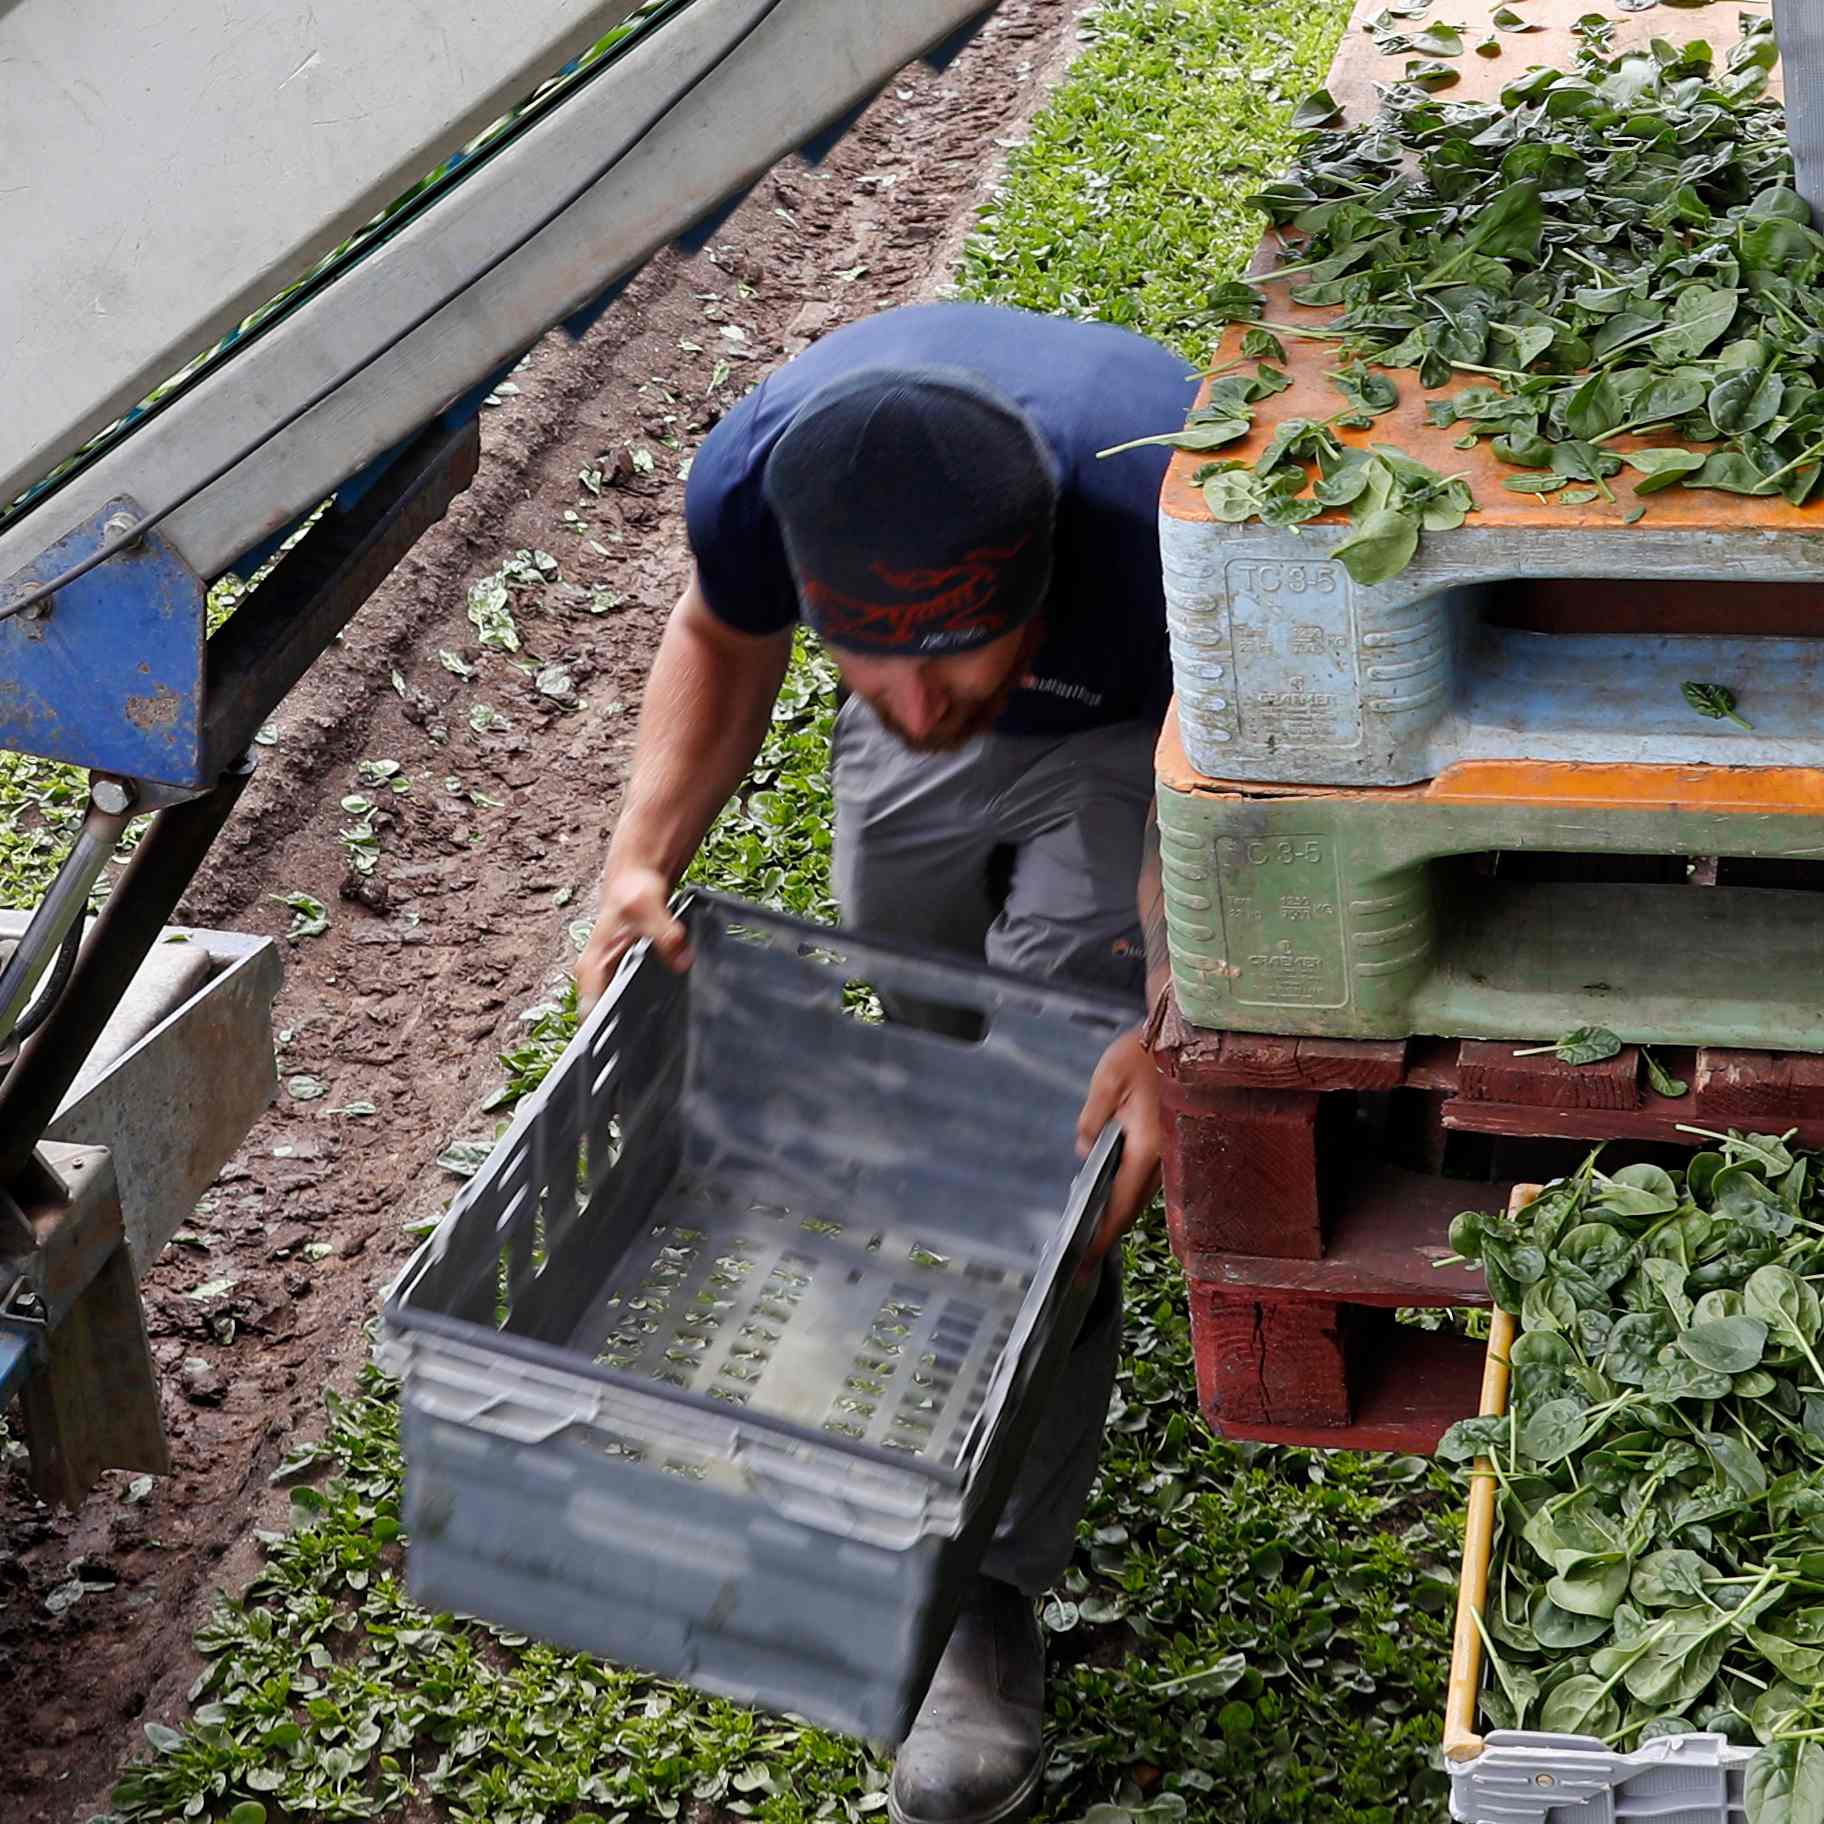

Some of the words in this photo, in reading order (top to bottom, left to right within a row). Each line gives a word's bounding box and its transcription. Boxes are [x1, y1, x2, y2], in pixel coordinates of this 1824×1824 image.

[1238, 564, 1281, 593] TC
[1287, 566, 1337, 594] 3-5
[1277, 840, 1323, 864] 3-5
